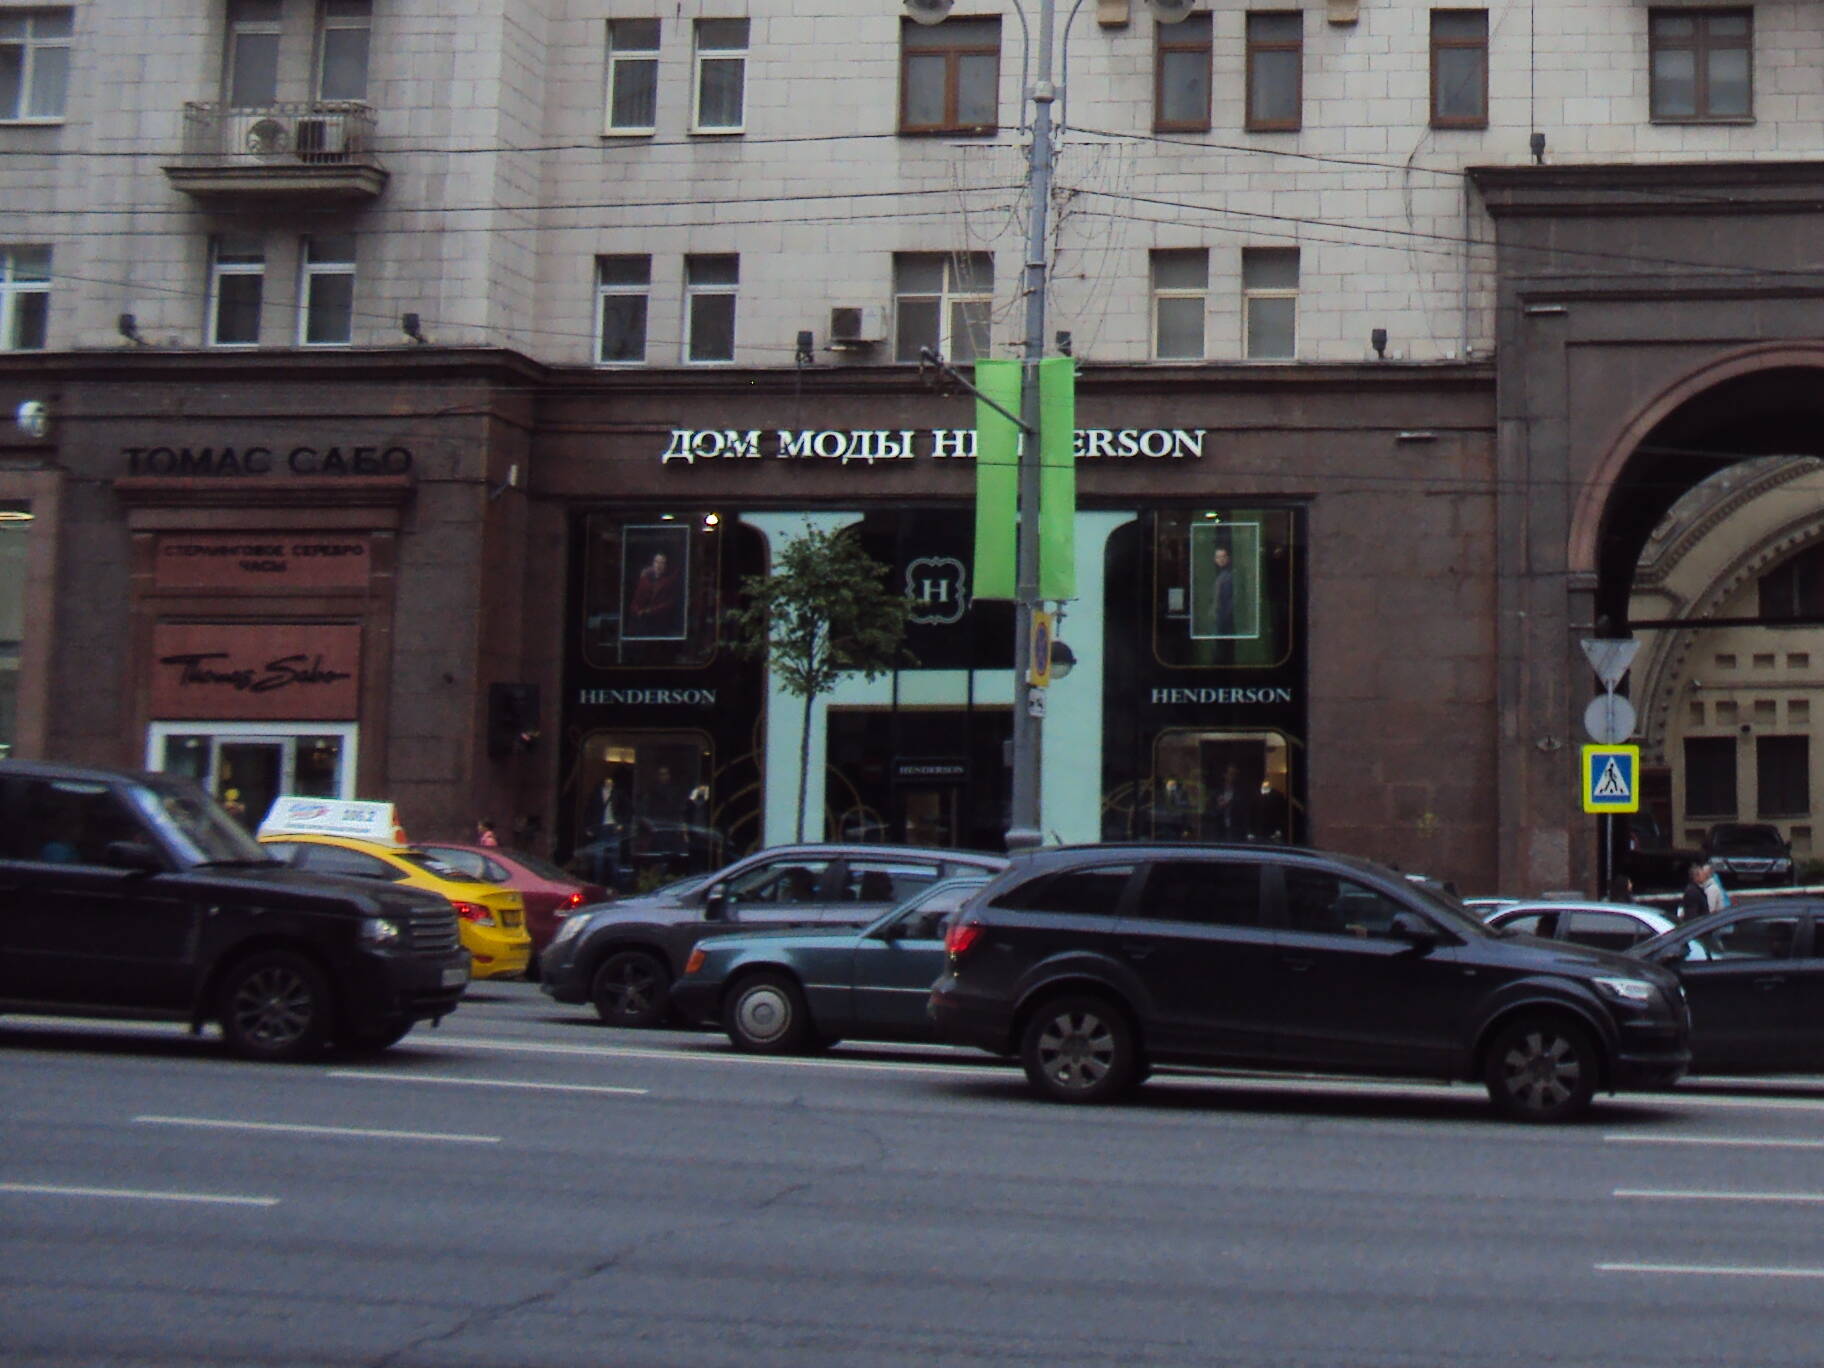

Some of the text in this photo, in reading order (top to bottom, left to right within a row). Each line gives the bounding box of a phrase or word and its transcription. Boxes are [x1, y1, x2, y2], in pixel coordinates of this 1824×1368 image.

[662, 430, 762, 464] ДОМ
[776, 430, 915, 465] МОДЫ
[121, 446, 413, 475] ТОМАС САБО
[922, 579, 949, 603] H
[579, 688, 717, 705] HENDERSON
[1151, 687, 1292, 704] HENDERSON
